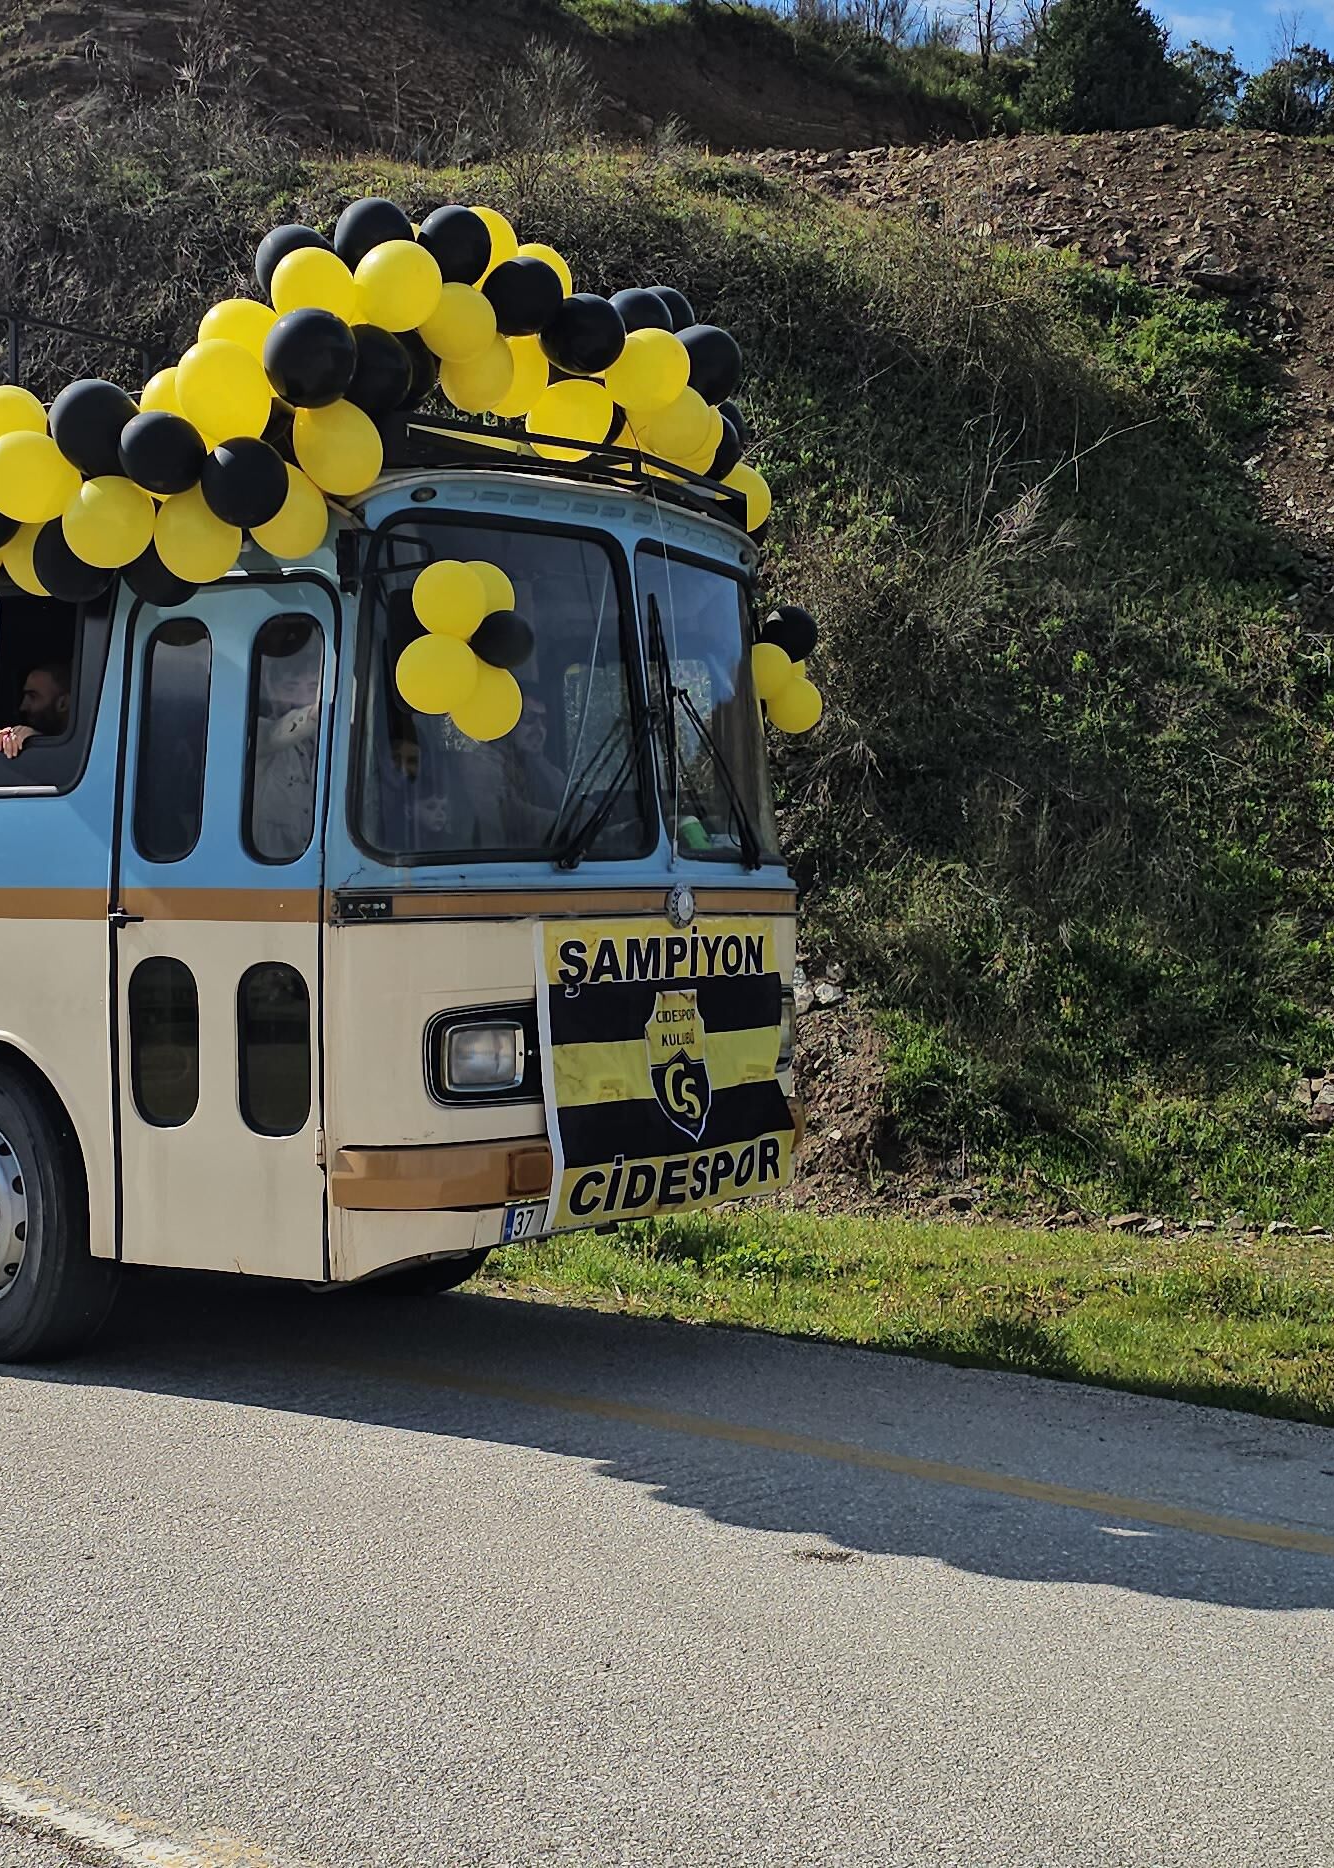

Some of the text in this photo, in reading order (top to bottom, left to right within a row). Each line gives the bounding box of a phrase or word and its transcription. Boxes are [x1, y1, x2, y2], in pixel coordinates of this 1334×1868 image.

[558, 926, 765, 998] ŞAMPİYON
[664, 1062, 701, 1119] CS
[568, 1137, 781, 1217] CİDESPOR
[513, 1209, 535, 1237] 37
